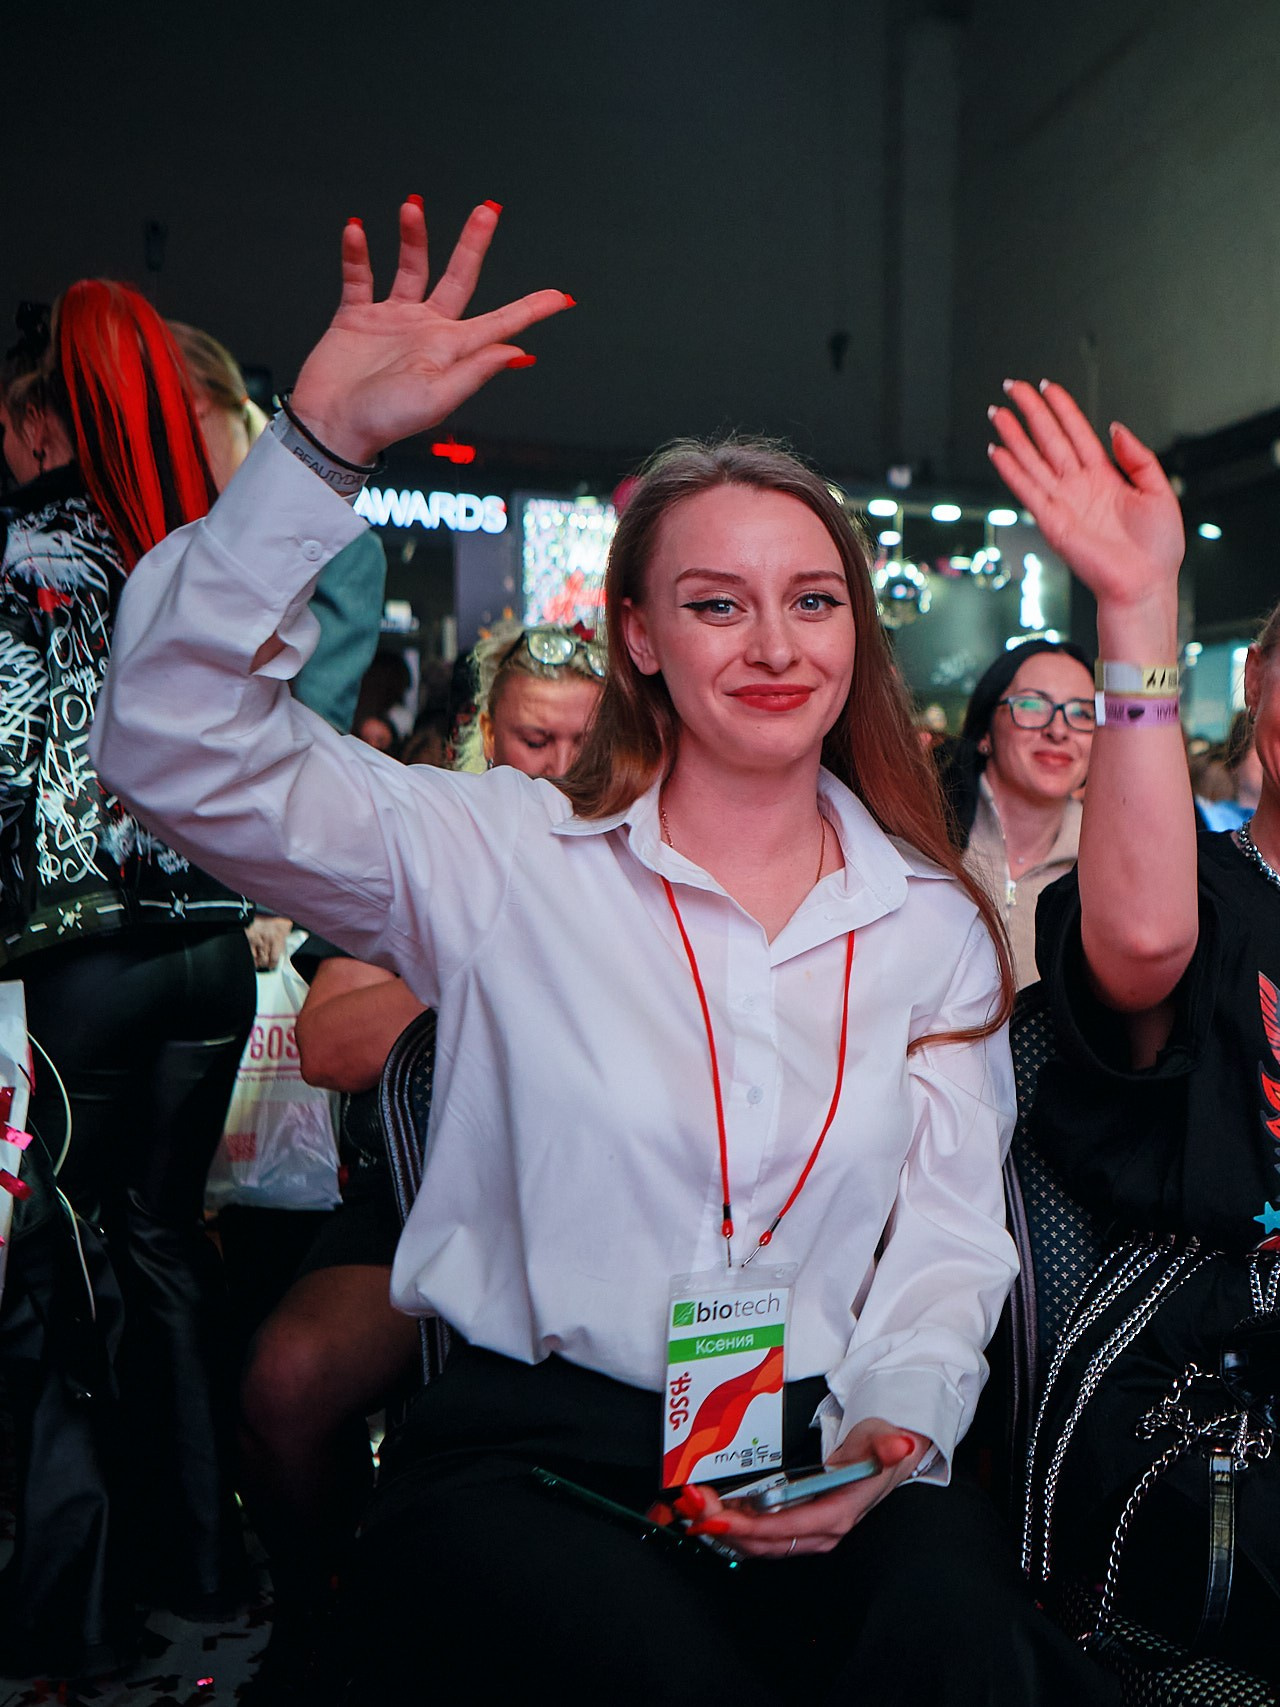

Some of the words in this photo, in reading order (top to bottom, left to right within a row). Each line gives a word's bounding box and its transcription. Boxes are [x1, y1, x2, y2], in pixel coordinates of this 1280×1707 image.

[352, 485, 507, 535] AWARDS
[696, 1292, 780, 1323] biotech
[695, 1333, 754, 1355] Ксения
